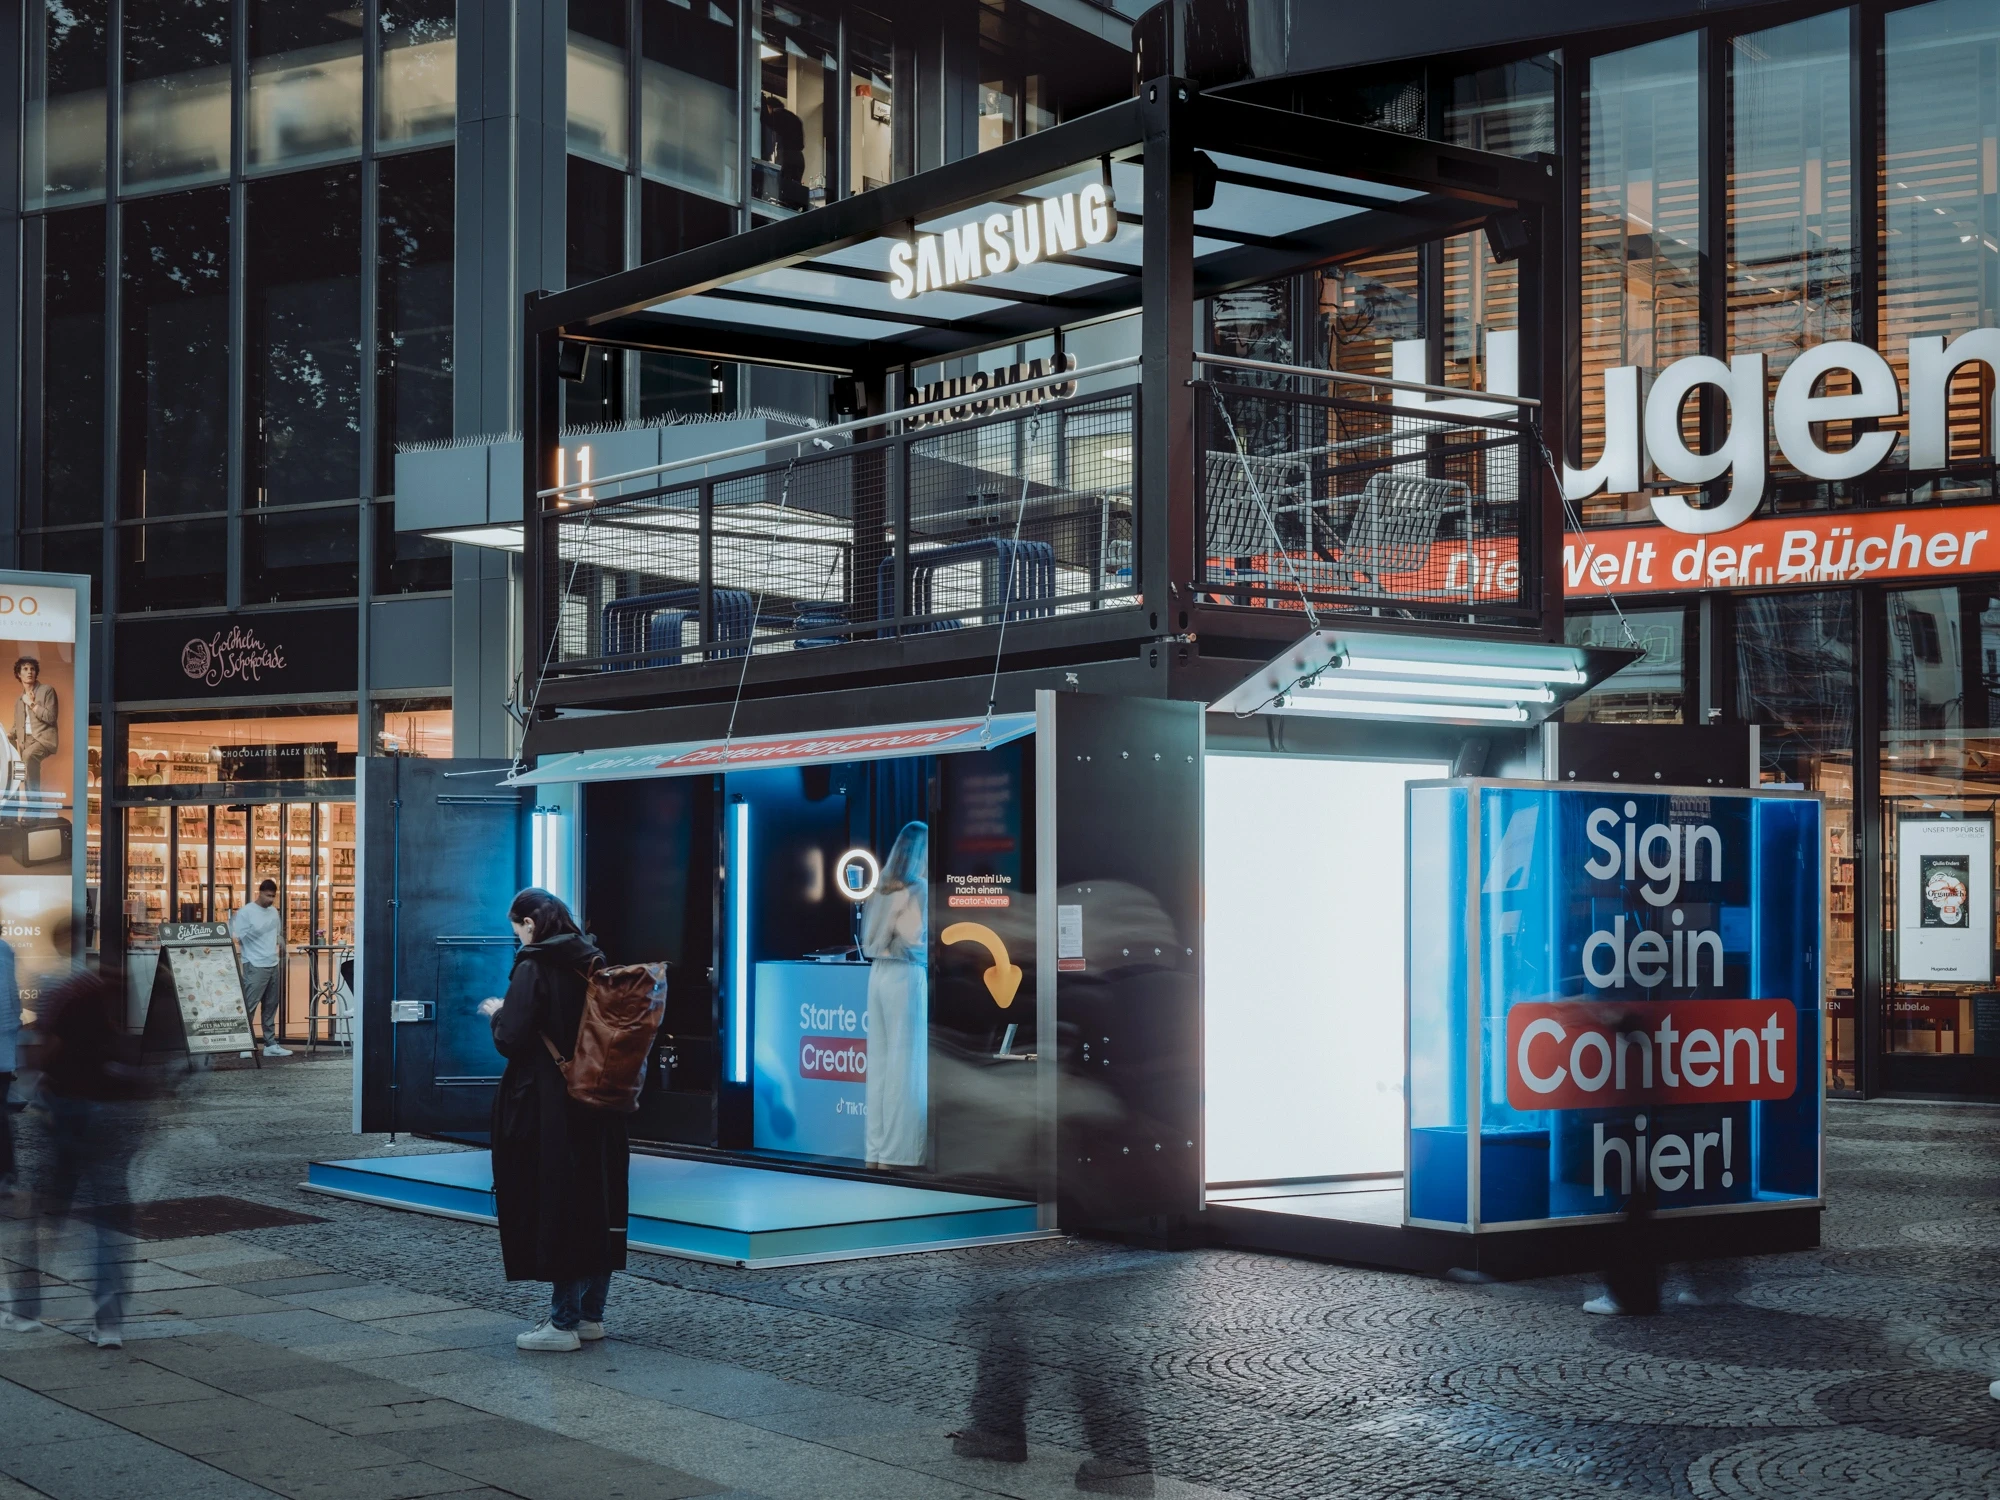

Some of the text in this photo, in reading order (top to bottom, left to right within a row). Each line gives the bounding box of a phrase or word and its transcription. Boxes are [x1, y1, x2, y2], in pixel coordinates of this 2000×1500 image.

[889, 183, 1112, 300] SAMSUNG
[1563, 540, 1657, 588] Welt
[1671, 538, 1765, 583] der
[1777, 523, 1988, 576] Bücher
[221, 746, 327, 759] CHOCOLATIER ALEX KÜHN
[1960, 825, 1974, 833] FÜR
[1584, 800, 1722, 907] Sign
[946, 874, 1012, 886] Frag Gemini Live
[949, 896, 1009, 906] Creator-Name
[955, 885, 1003, 895] nach einem
[1581, 908, 1724, 989] dein
[800, 1003, 857, 1033] Starte
[1517, 1011, 1785, 1094] Content
[1593, 1114, 1734, 1198] hier!
